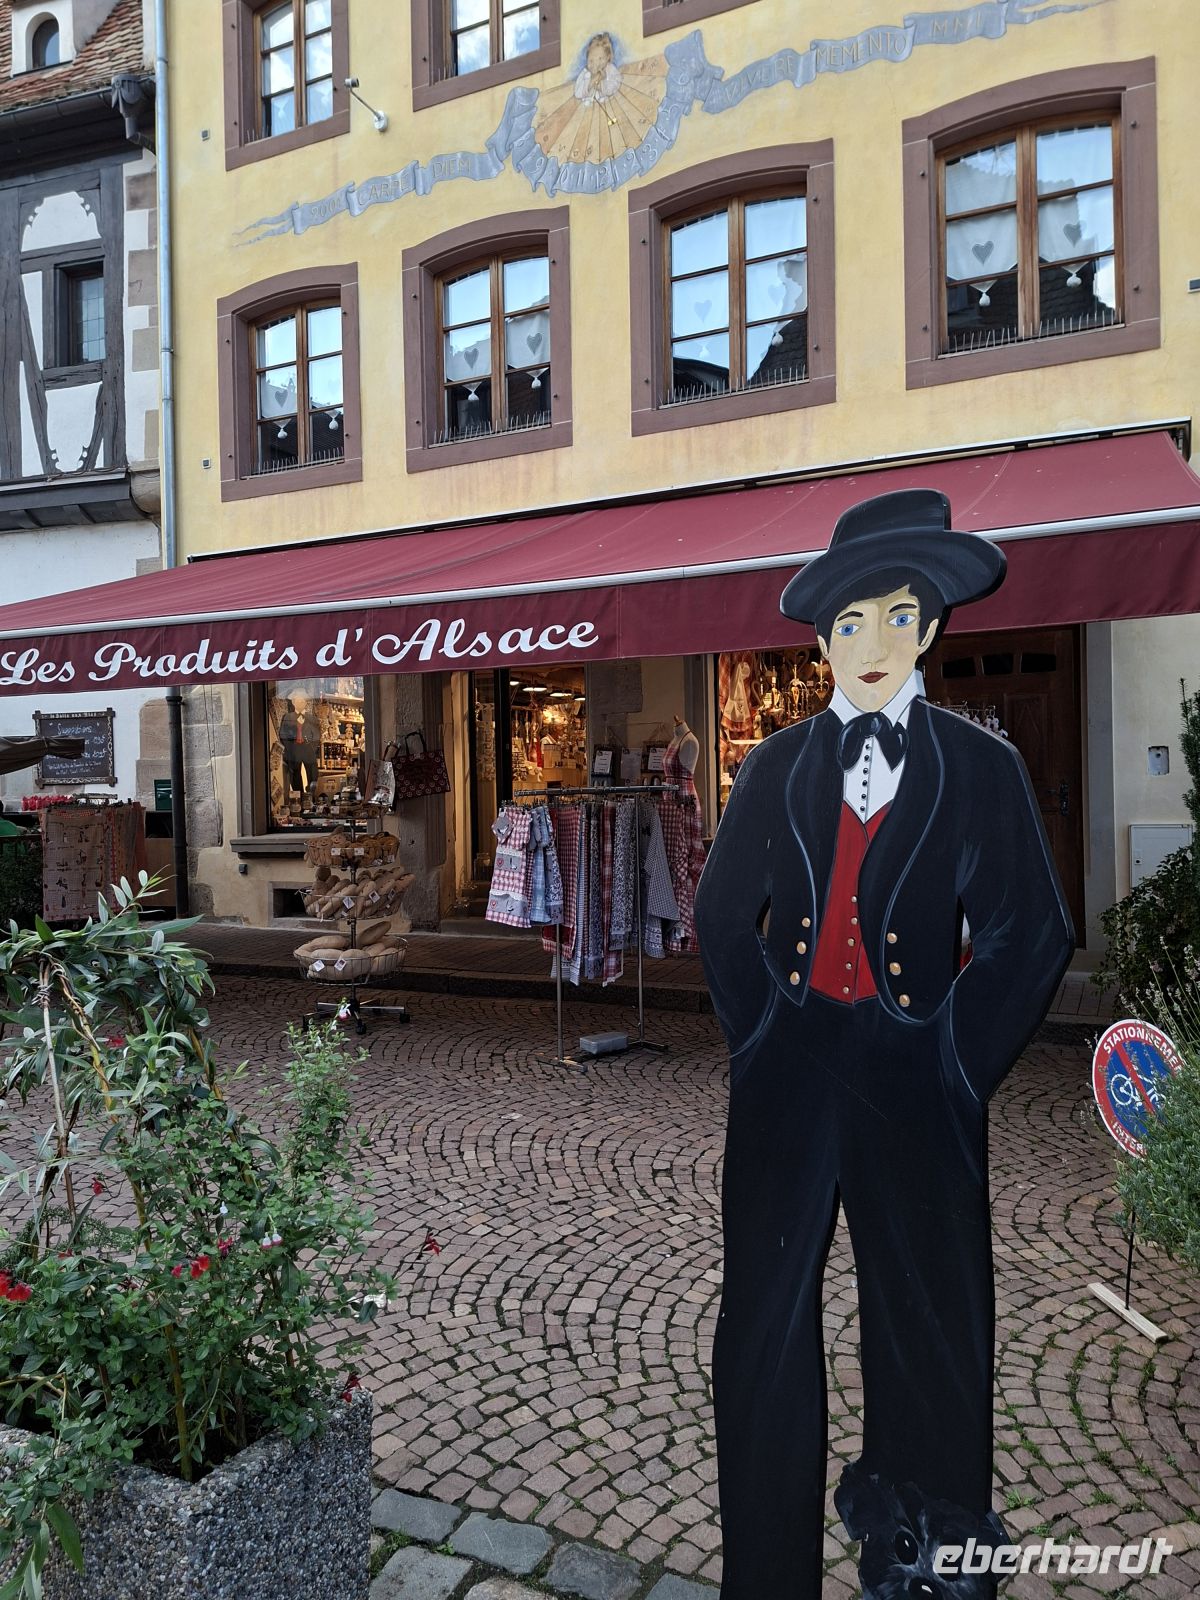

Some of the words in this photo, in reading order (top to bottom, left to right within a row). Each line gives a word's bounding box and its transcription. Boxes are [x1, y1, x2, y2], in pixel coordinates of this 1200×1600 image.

[725, 55, 794, 101] VIVERE
[816, 32, 907, 67] MEMENTO
[357, 169, 410, 206] CARPE
[431, 159, 471, 179] DIEM
[0, 648, 75, 685] Les
[88, 639, 298, 681] Produits
[316, 628, 363, 667] d'
[372, 618, 598, 664] Alsace
